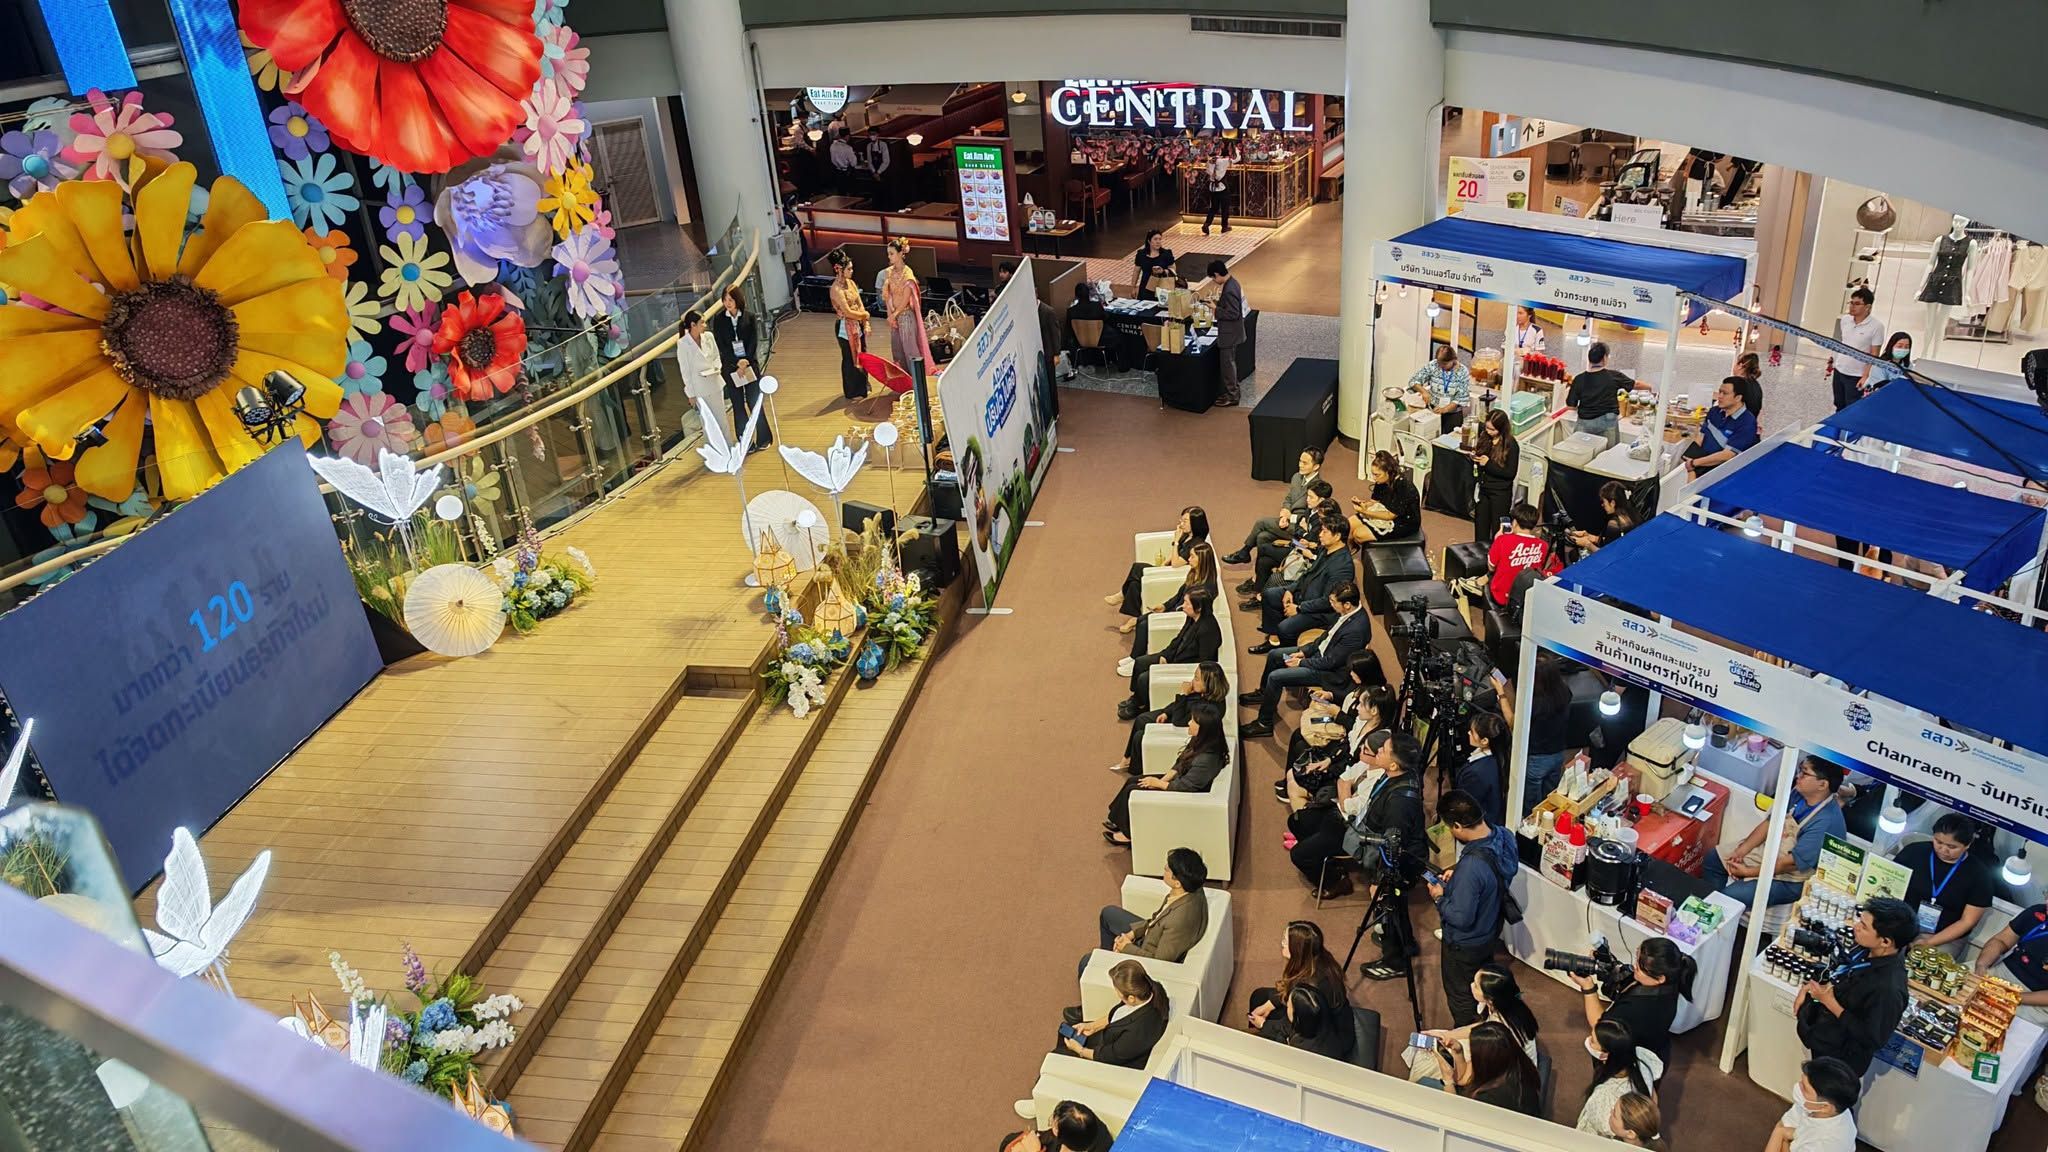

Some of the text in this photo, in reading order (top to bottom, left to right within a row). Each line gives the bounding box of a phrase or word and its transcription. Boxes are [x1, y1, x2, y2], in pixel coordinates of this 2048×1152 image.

[1050, 86, 1314, 132] CENTRAL
[1510, 128, 1517, 148] 1
[1400, 264, 1482, 284] บริษัท วินเนอร์โฮม จำกัด
[1554, 288, 1600, 307] ข้าวกระยาคู
[1509, 543, 1542, 560] Acid
[1511, 552, 1542, 570] angel
[1622, 618, 1646, 634] สสว
[112, 570, 292, 715] มากกว่า 120 ราย
[1606, 631, 1711, 677] วิสาหกิจผลิตและแปรรูป
[1595, 641, 1718, 698] สินค้าเกษตรทุ่งใหญ่
[1921, 728, 1954, 748] สสว
[1867, 740, 1962, 786] Chanraem
